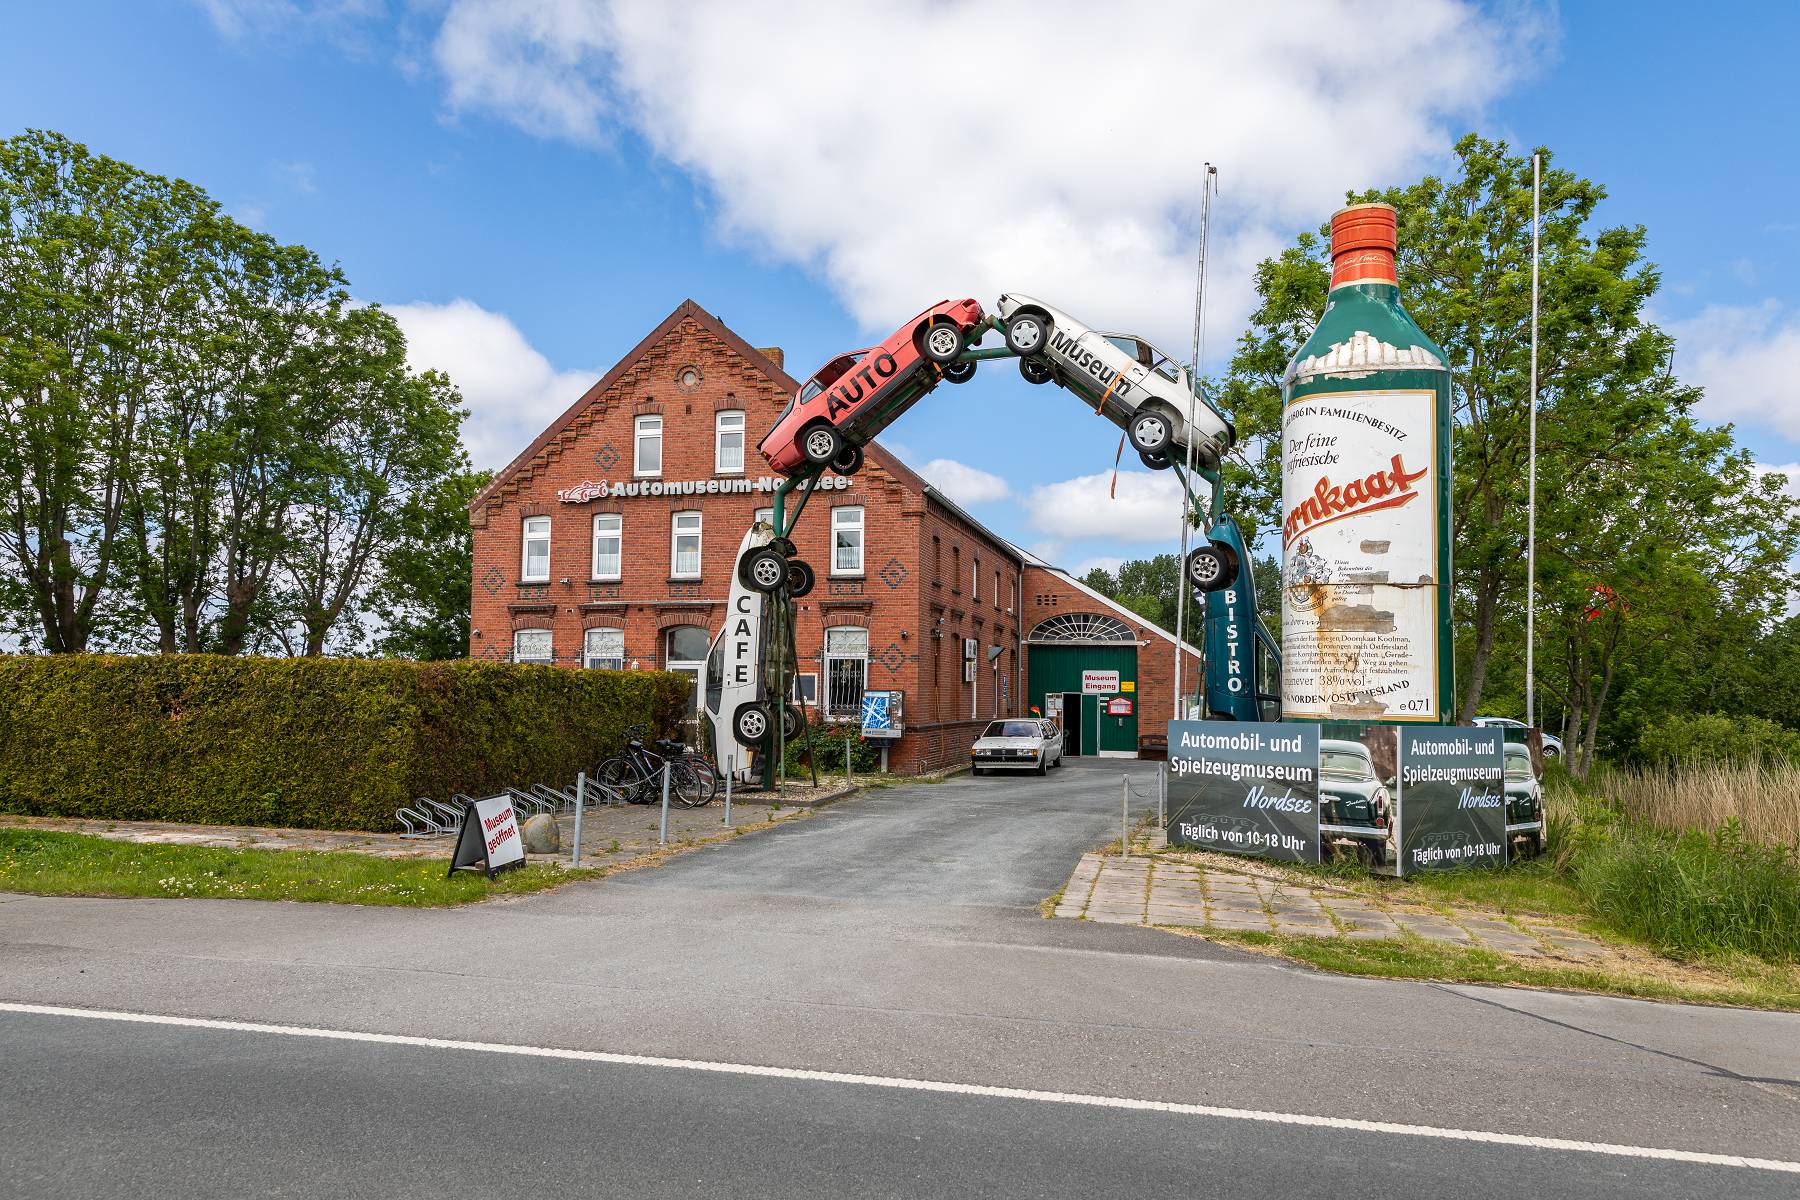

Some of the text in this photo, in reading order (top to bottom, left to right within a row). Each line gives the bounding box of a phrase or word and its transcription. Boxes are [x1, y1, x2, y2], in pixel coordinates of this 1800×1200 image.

[1050, 330, 1132, 398] Museum
[827, 353, 898, 421] AUTO
[1306, 407, 1317, 416] IN
[1320, 407, 1407, 442] FAMILIENBESITZ
[1289, 433, 1338, 454] Der feine
[734, 596, 752, 683] CAFE
[1224, 590, 1242, 692] BISTRO
[1363, 659, 1377, 667] Weg
[1180, 731, 1302, 752] Automobil- und
[1410, 738, 1495, 756] Automobil- und
[1171, 756, 1312, 781] Spielzeugmuseum
[1403, 764, 1502, 787] Spielzeugmuseum
[1243, 785, 1312, 814] Nordsee
[1457, 786, 1501, 809] Nordsee
[484, 807, 513, 832] Museum
[1199, 815, 1249, 827] ROUTE
[487, 823, 516, 854] geöffnet
[1179, 822, 1306, 851] Täglich von 10-18 Uhr
[1412, 842, 1501, 864] Täglich von 10-18 Uhr
